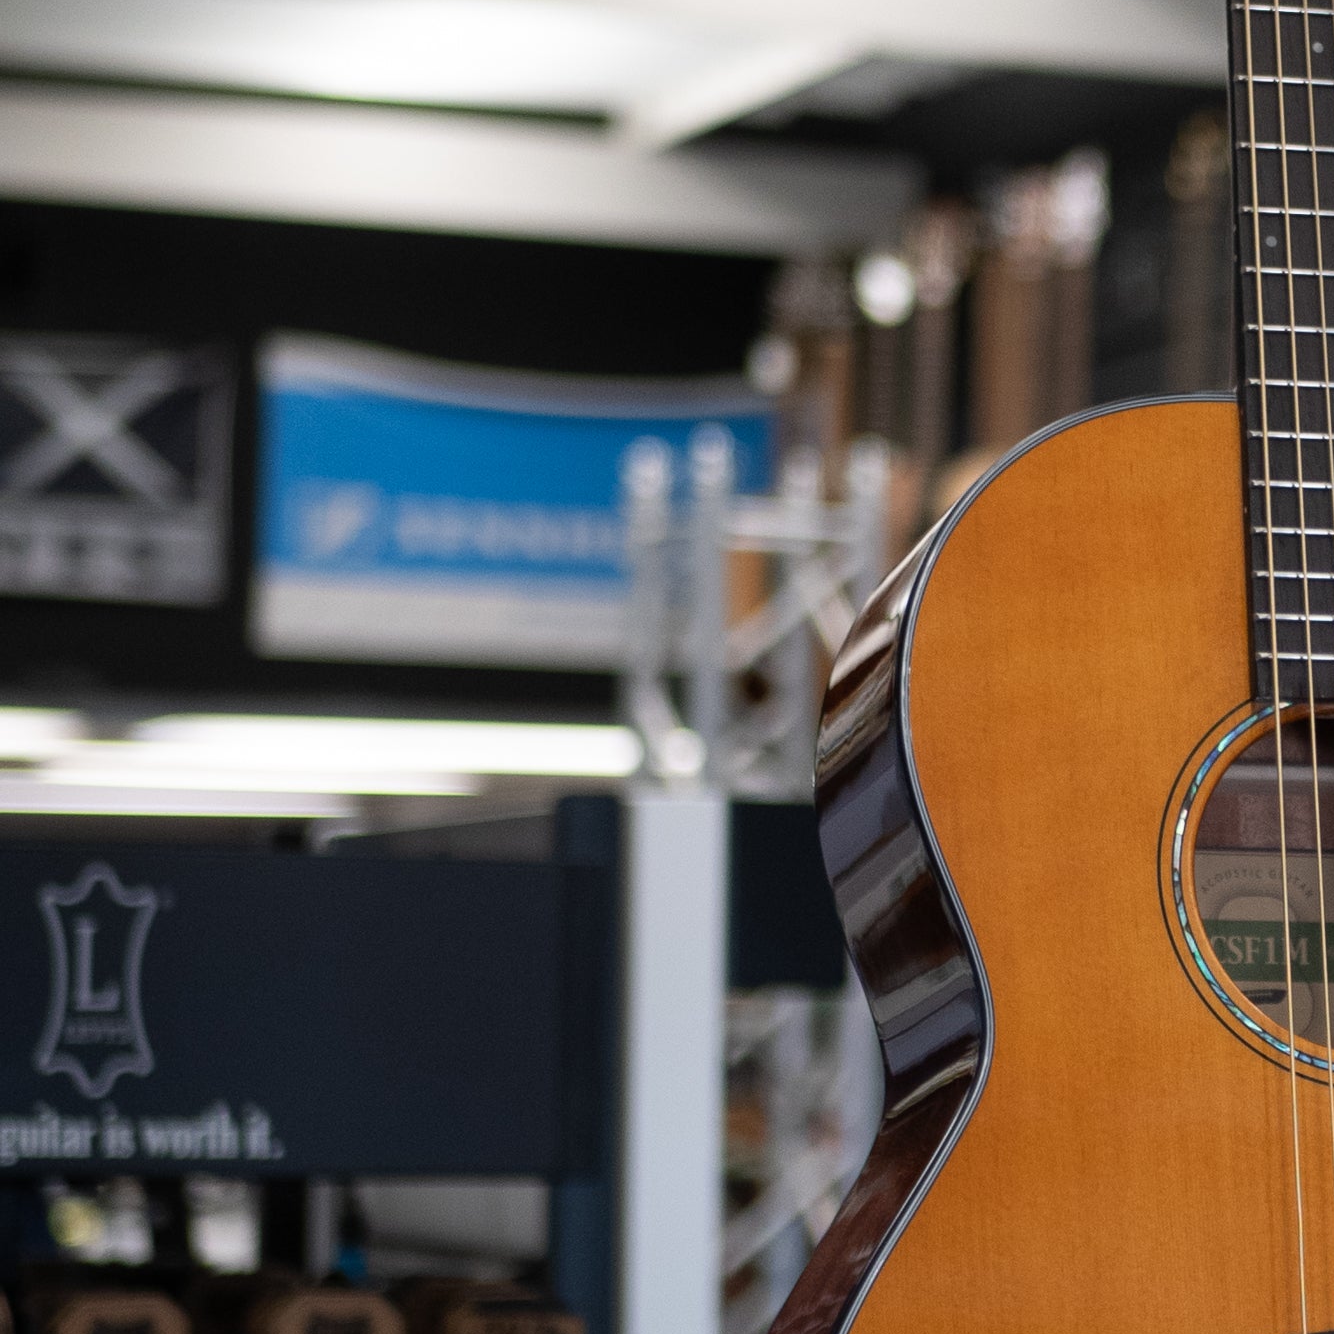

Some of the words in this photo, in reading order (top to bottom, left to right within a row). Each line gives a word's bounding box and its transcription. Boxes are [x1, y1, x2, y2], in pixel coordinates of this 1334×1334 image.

[76, 917, 121, 1012] L
[100, 1101, 137, 1159] is
[140, 1099, 240, 1159] worth
